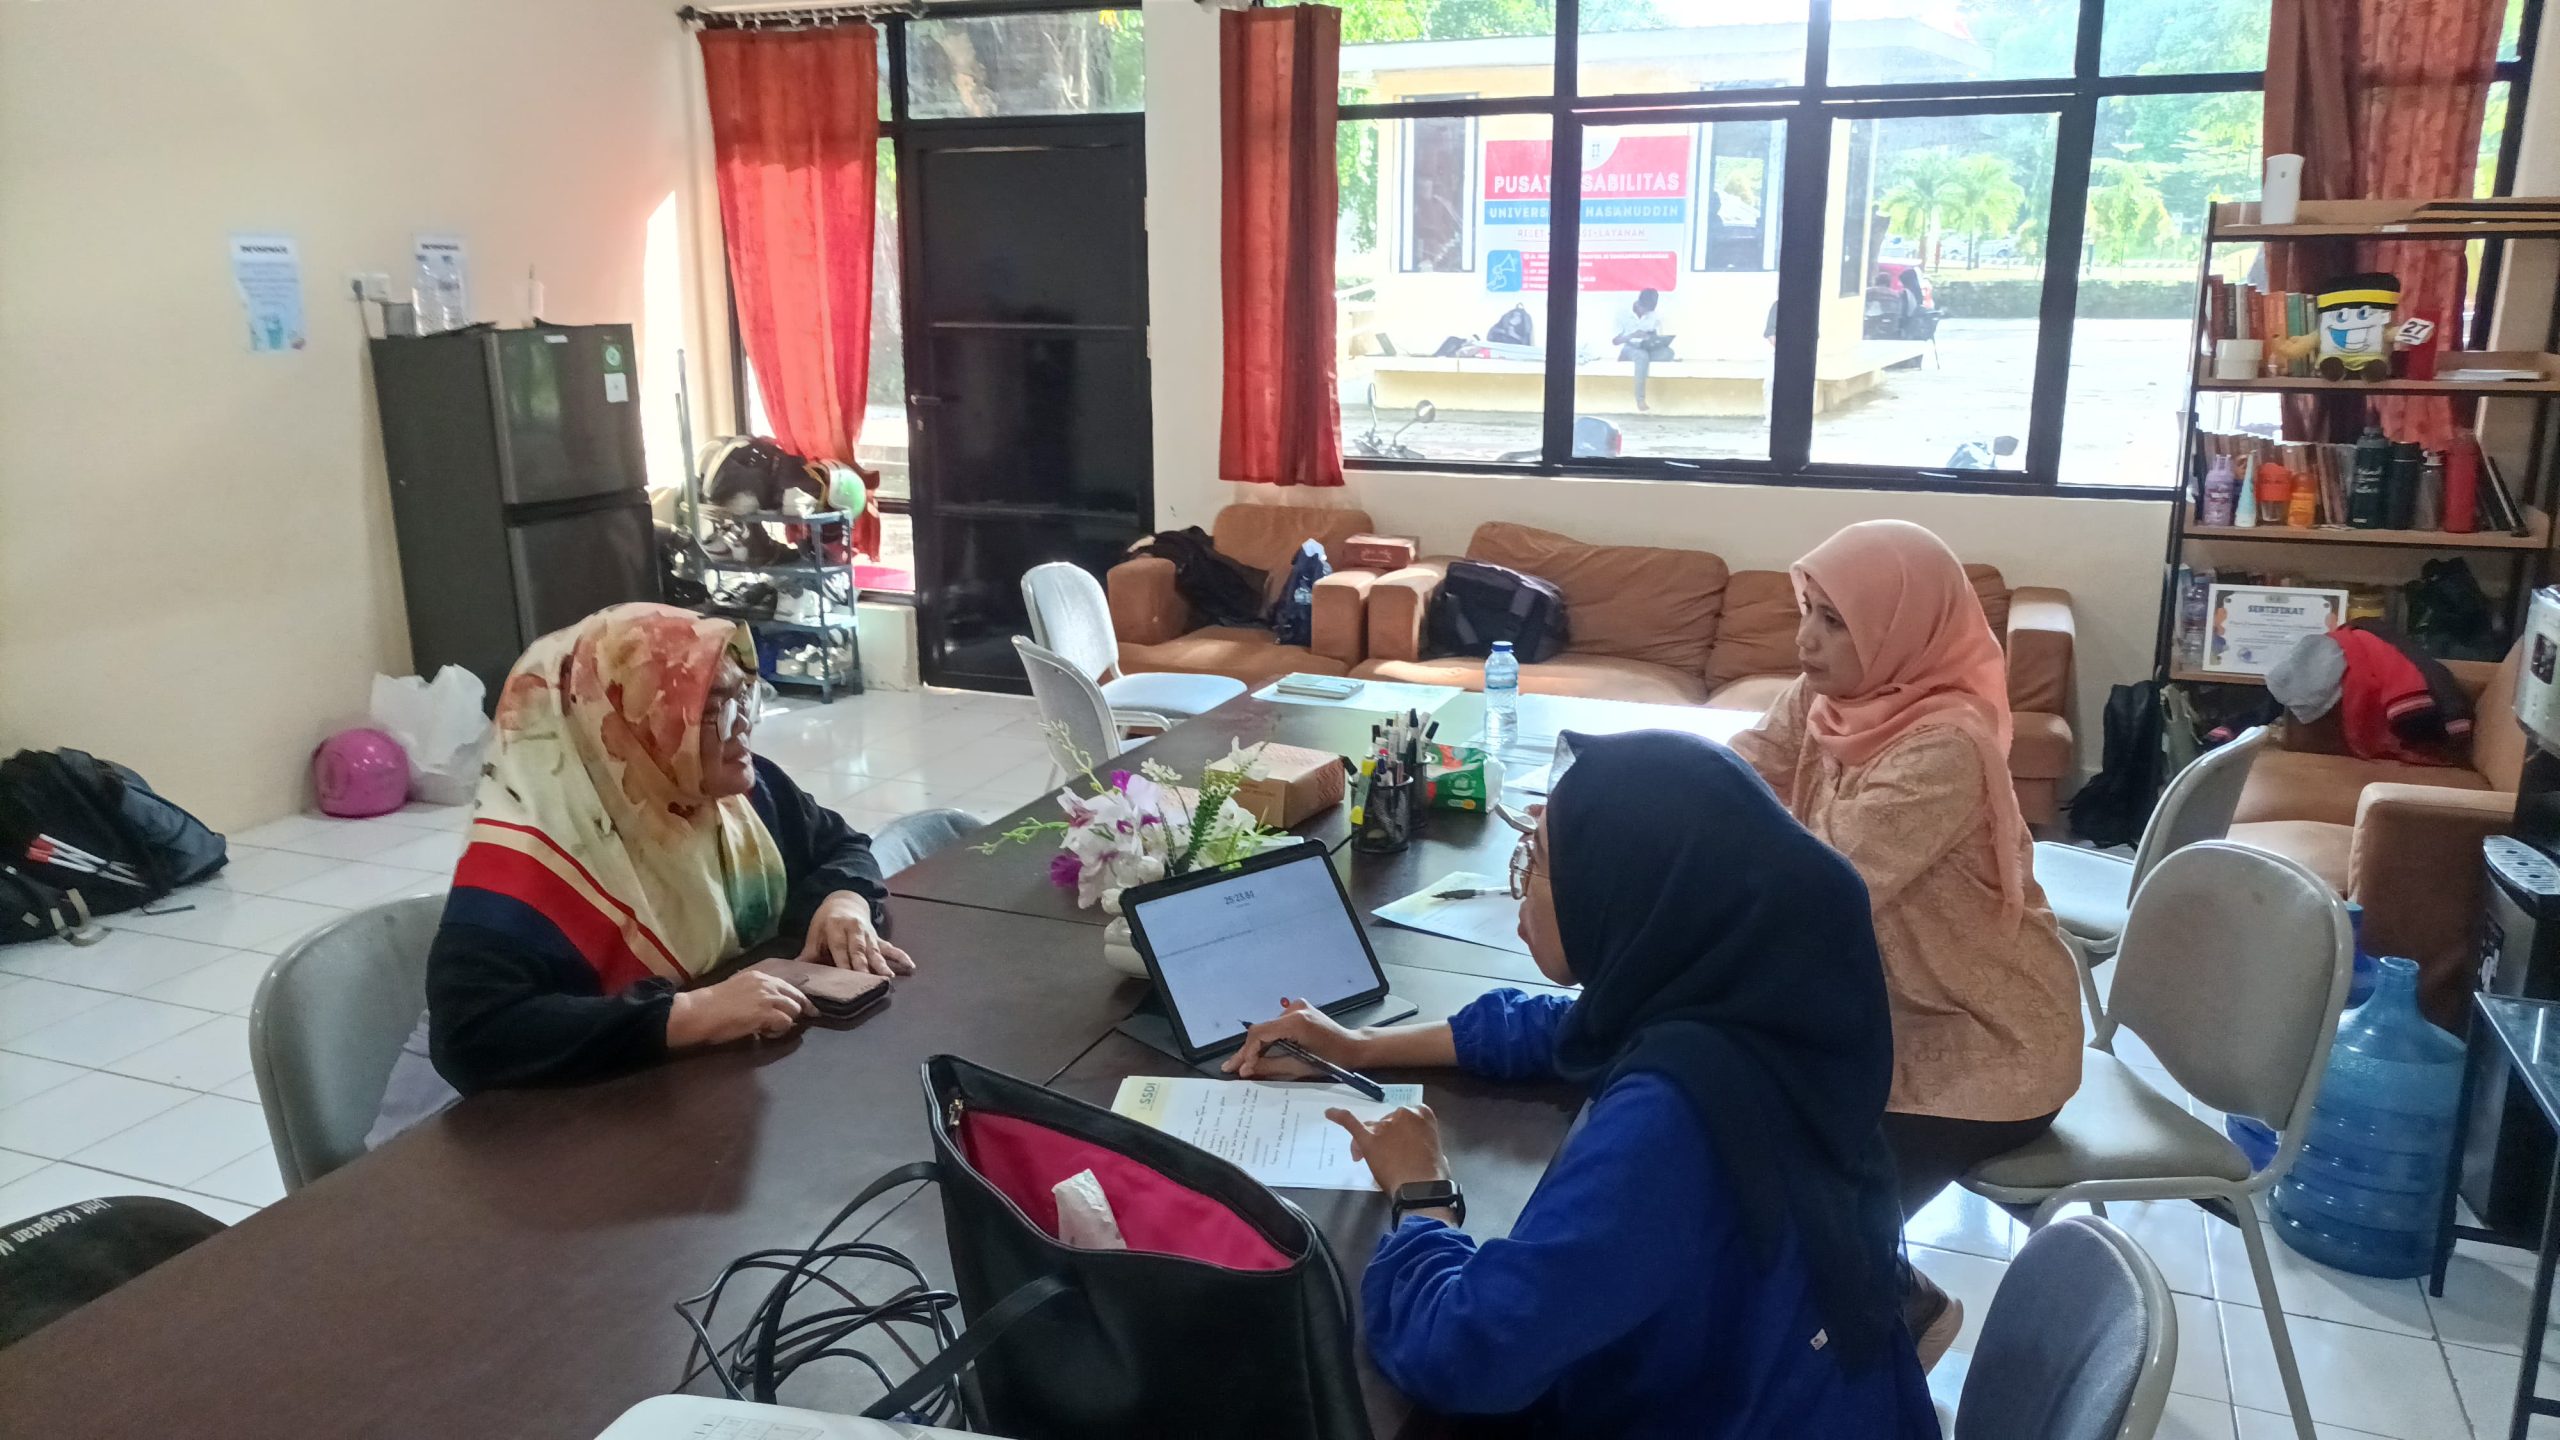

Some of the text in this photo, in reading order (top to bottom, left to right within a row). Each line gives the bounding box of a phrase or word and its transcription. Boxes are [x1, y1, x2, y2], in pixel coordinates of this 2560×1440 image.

[1581, 172, 1680, 192] SABILITAS
[1489, 205, 1679, 218] UNIVERS HASANUDDIN
[2402, 321, 2430, 335] 27
[76, 1198, 112, 1215] Unit
[10, 1209, 82, 1243] Kegiatan
